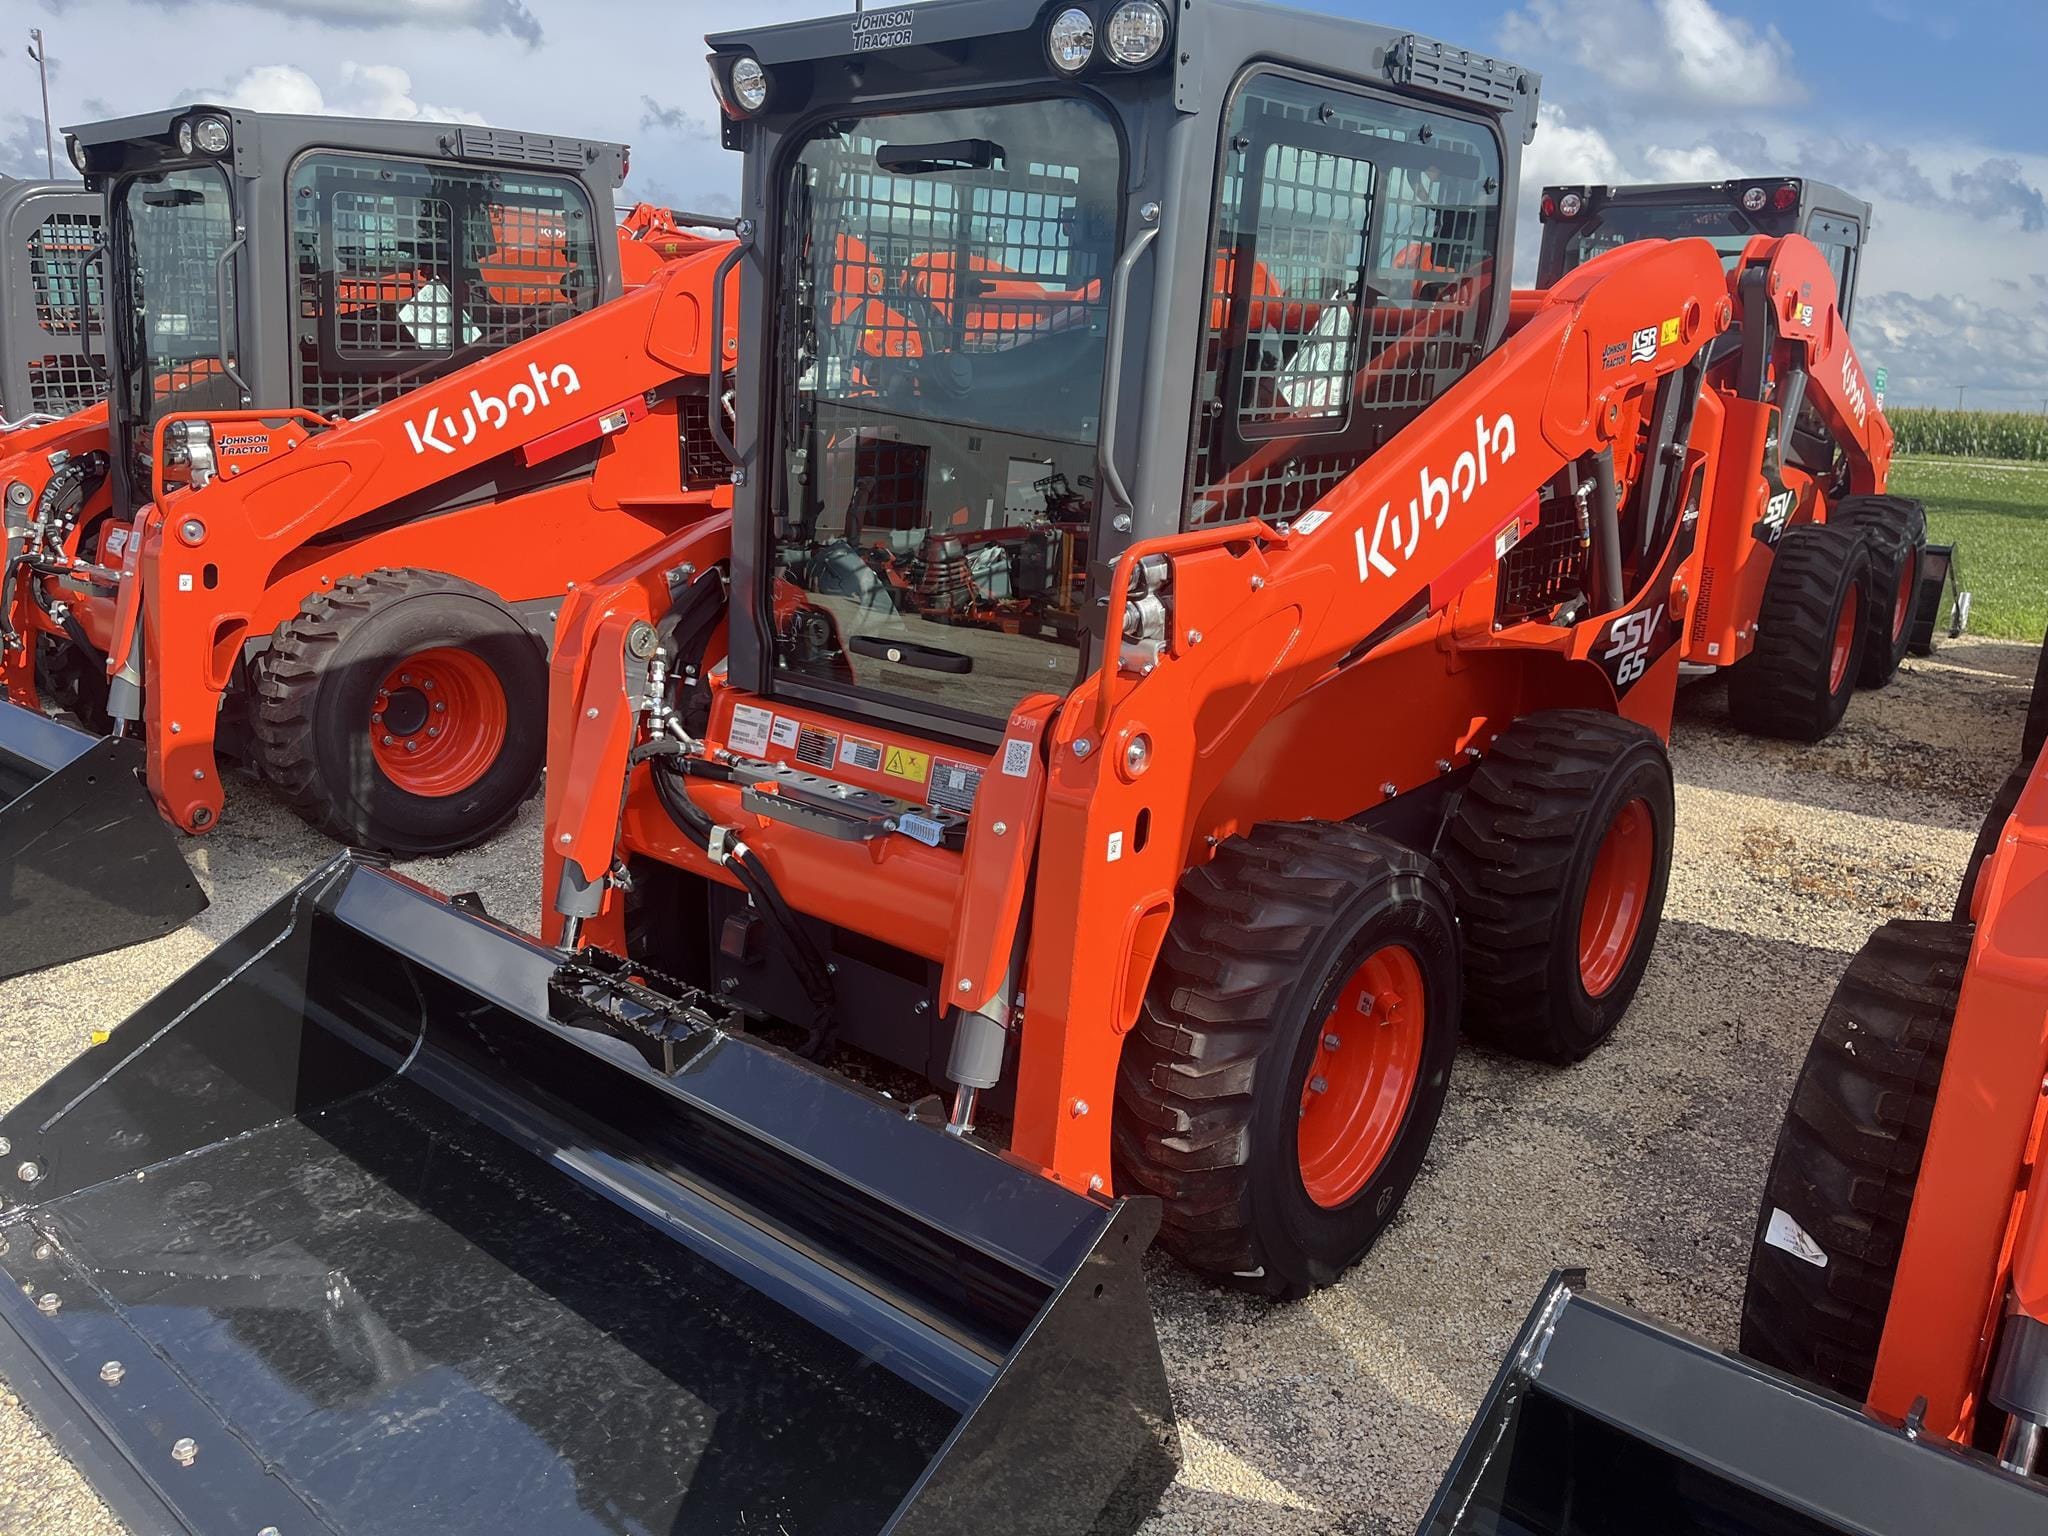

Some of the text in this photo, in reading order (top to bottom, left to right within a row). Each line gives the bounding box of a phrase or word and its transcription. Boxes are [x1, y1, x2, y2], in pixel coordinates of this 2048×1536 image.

[851, 9, 914, 33] JOHNSON
[852, 29, 913, 51] TRACTOR
[1632, 327, 1657, 351] KSR
[403, 362, 581, 454] Kubota
[217, 434, 269, 446] JOHNSON
[219, 444, 269, 456] TRACTOR
[1354, 413, 1516, 583] Kubota
[1763, 490, 1793, 525] SSV
[1767, 518, 1784, 543] 75
[1604, 603, 1664, 660] SSV
[1616, 646, 1649, 686] 65
